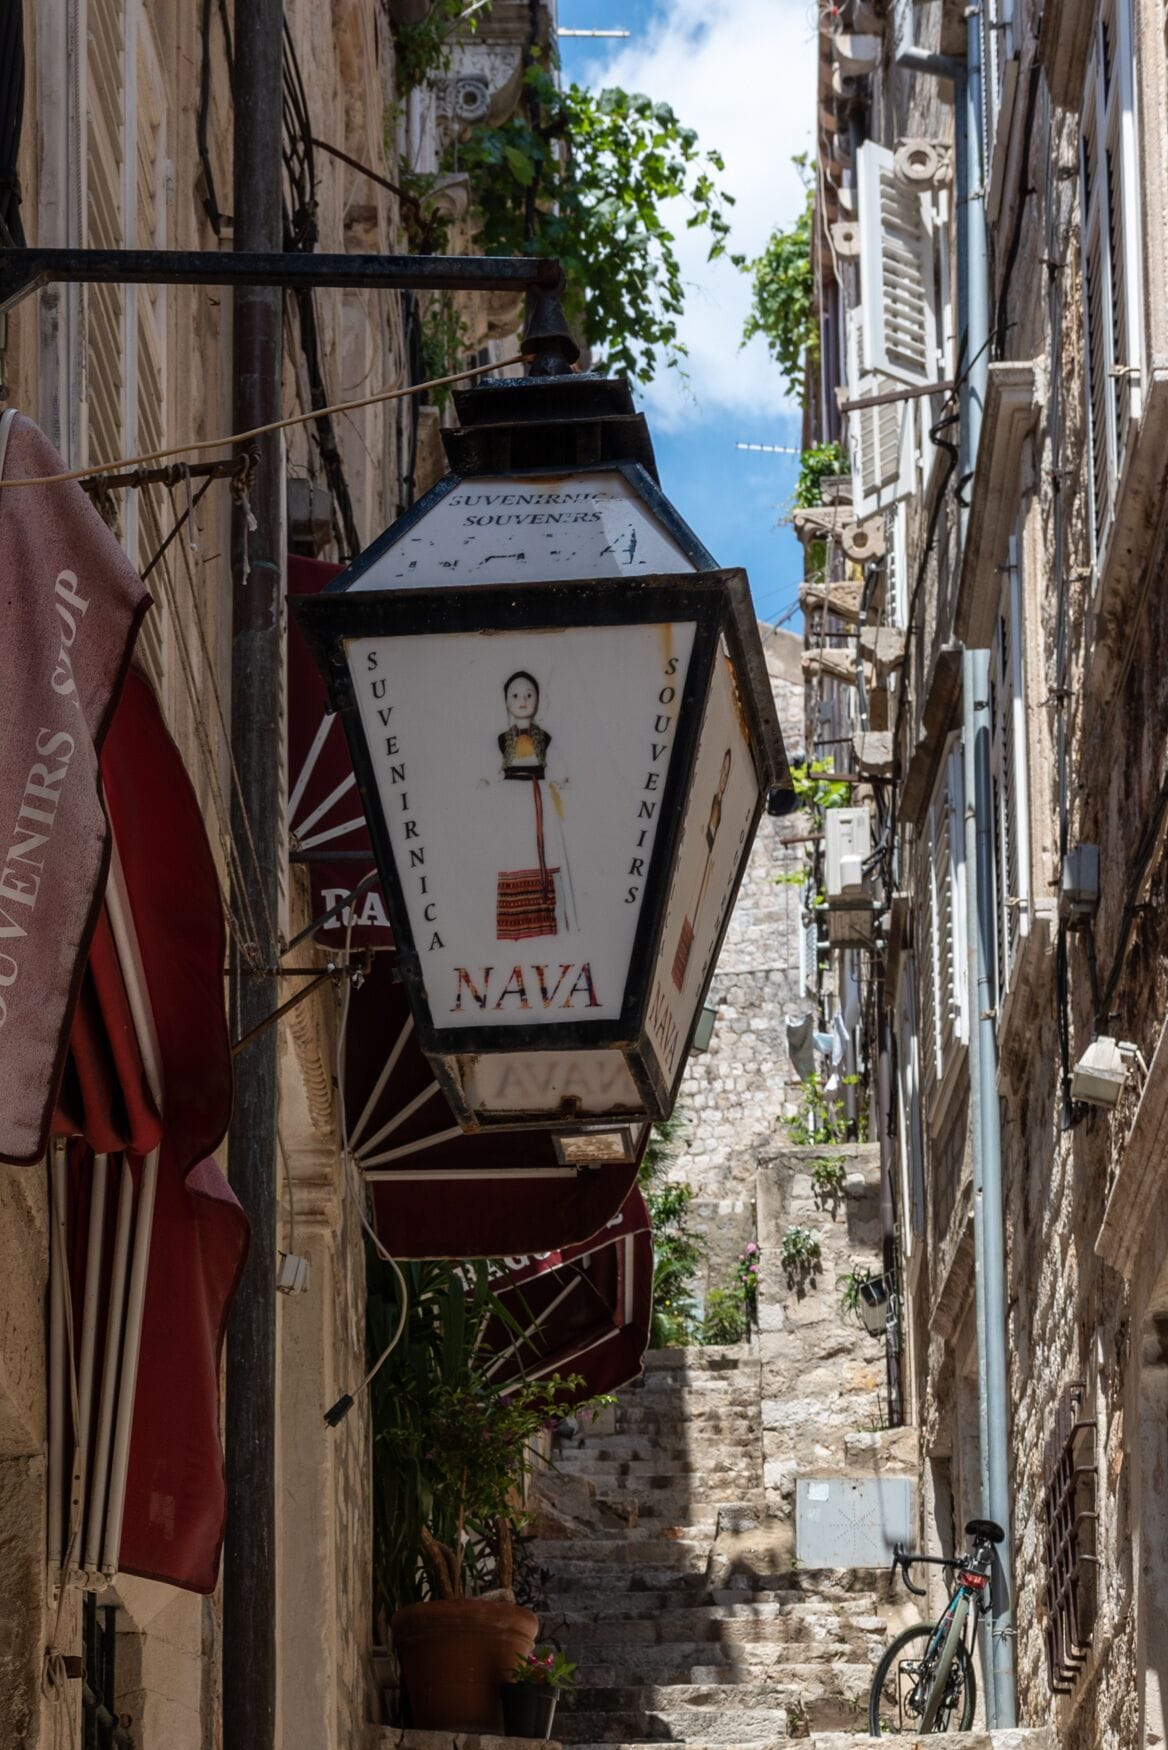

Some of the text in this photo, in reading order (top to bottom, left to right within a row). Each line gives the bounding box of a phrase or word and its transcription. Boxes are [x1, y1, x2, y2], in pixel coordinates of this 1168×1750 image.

[366, 651, 446, 951] SUVENIRNICA
[624, 657, 679, 904] SOUVENIRS
[449, 961, 602, 1013] NAVA
[648, 980, 679, 1075] NAVA
